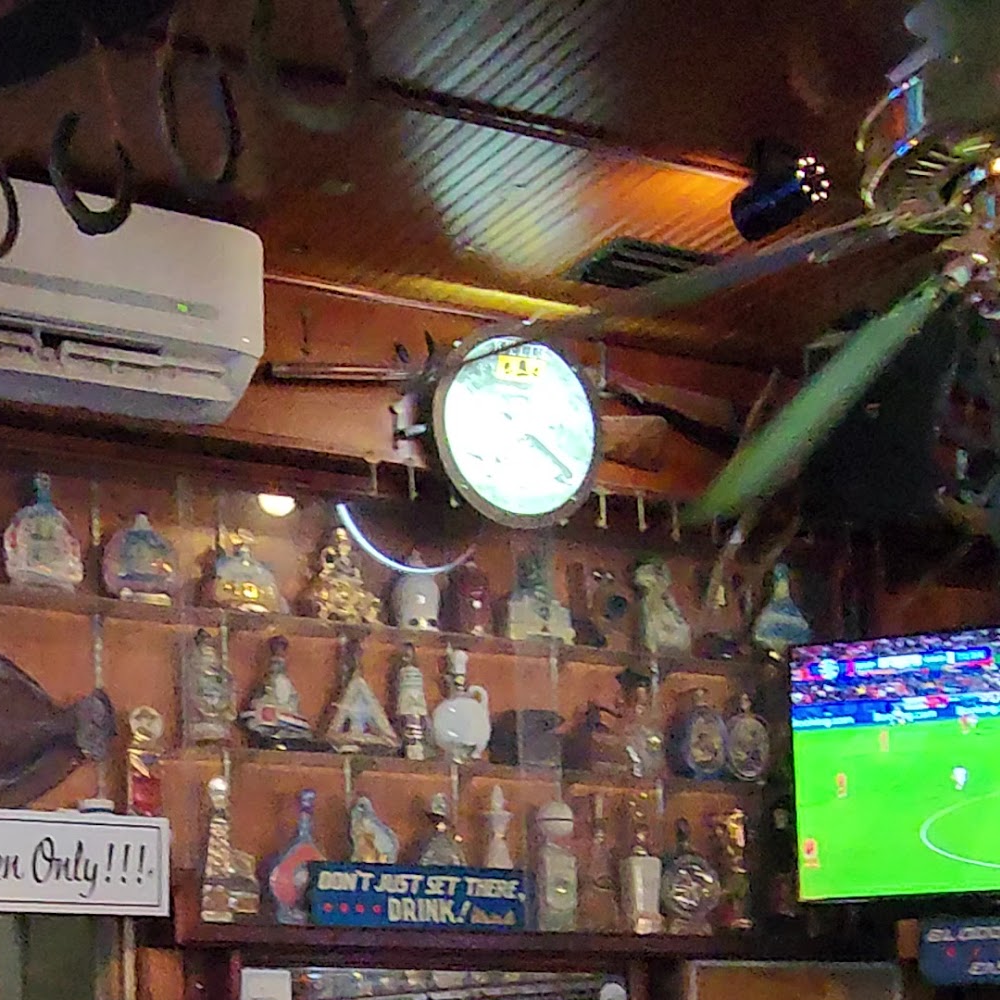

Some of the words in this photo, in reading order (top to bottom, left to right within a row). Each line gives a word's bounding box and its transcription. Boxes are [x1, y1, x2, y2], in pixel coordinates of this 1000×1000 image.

[31, 836, 148, 898] Only!!!
[317, 869, 376, 892] DON'T
[374, 873, 426, 895] JUST
[424, 875, 462, 896] SET
[387, 896, 473, 924] DRINK!
